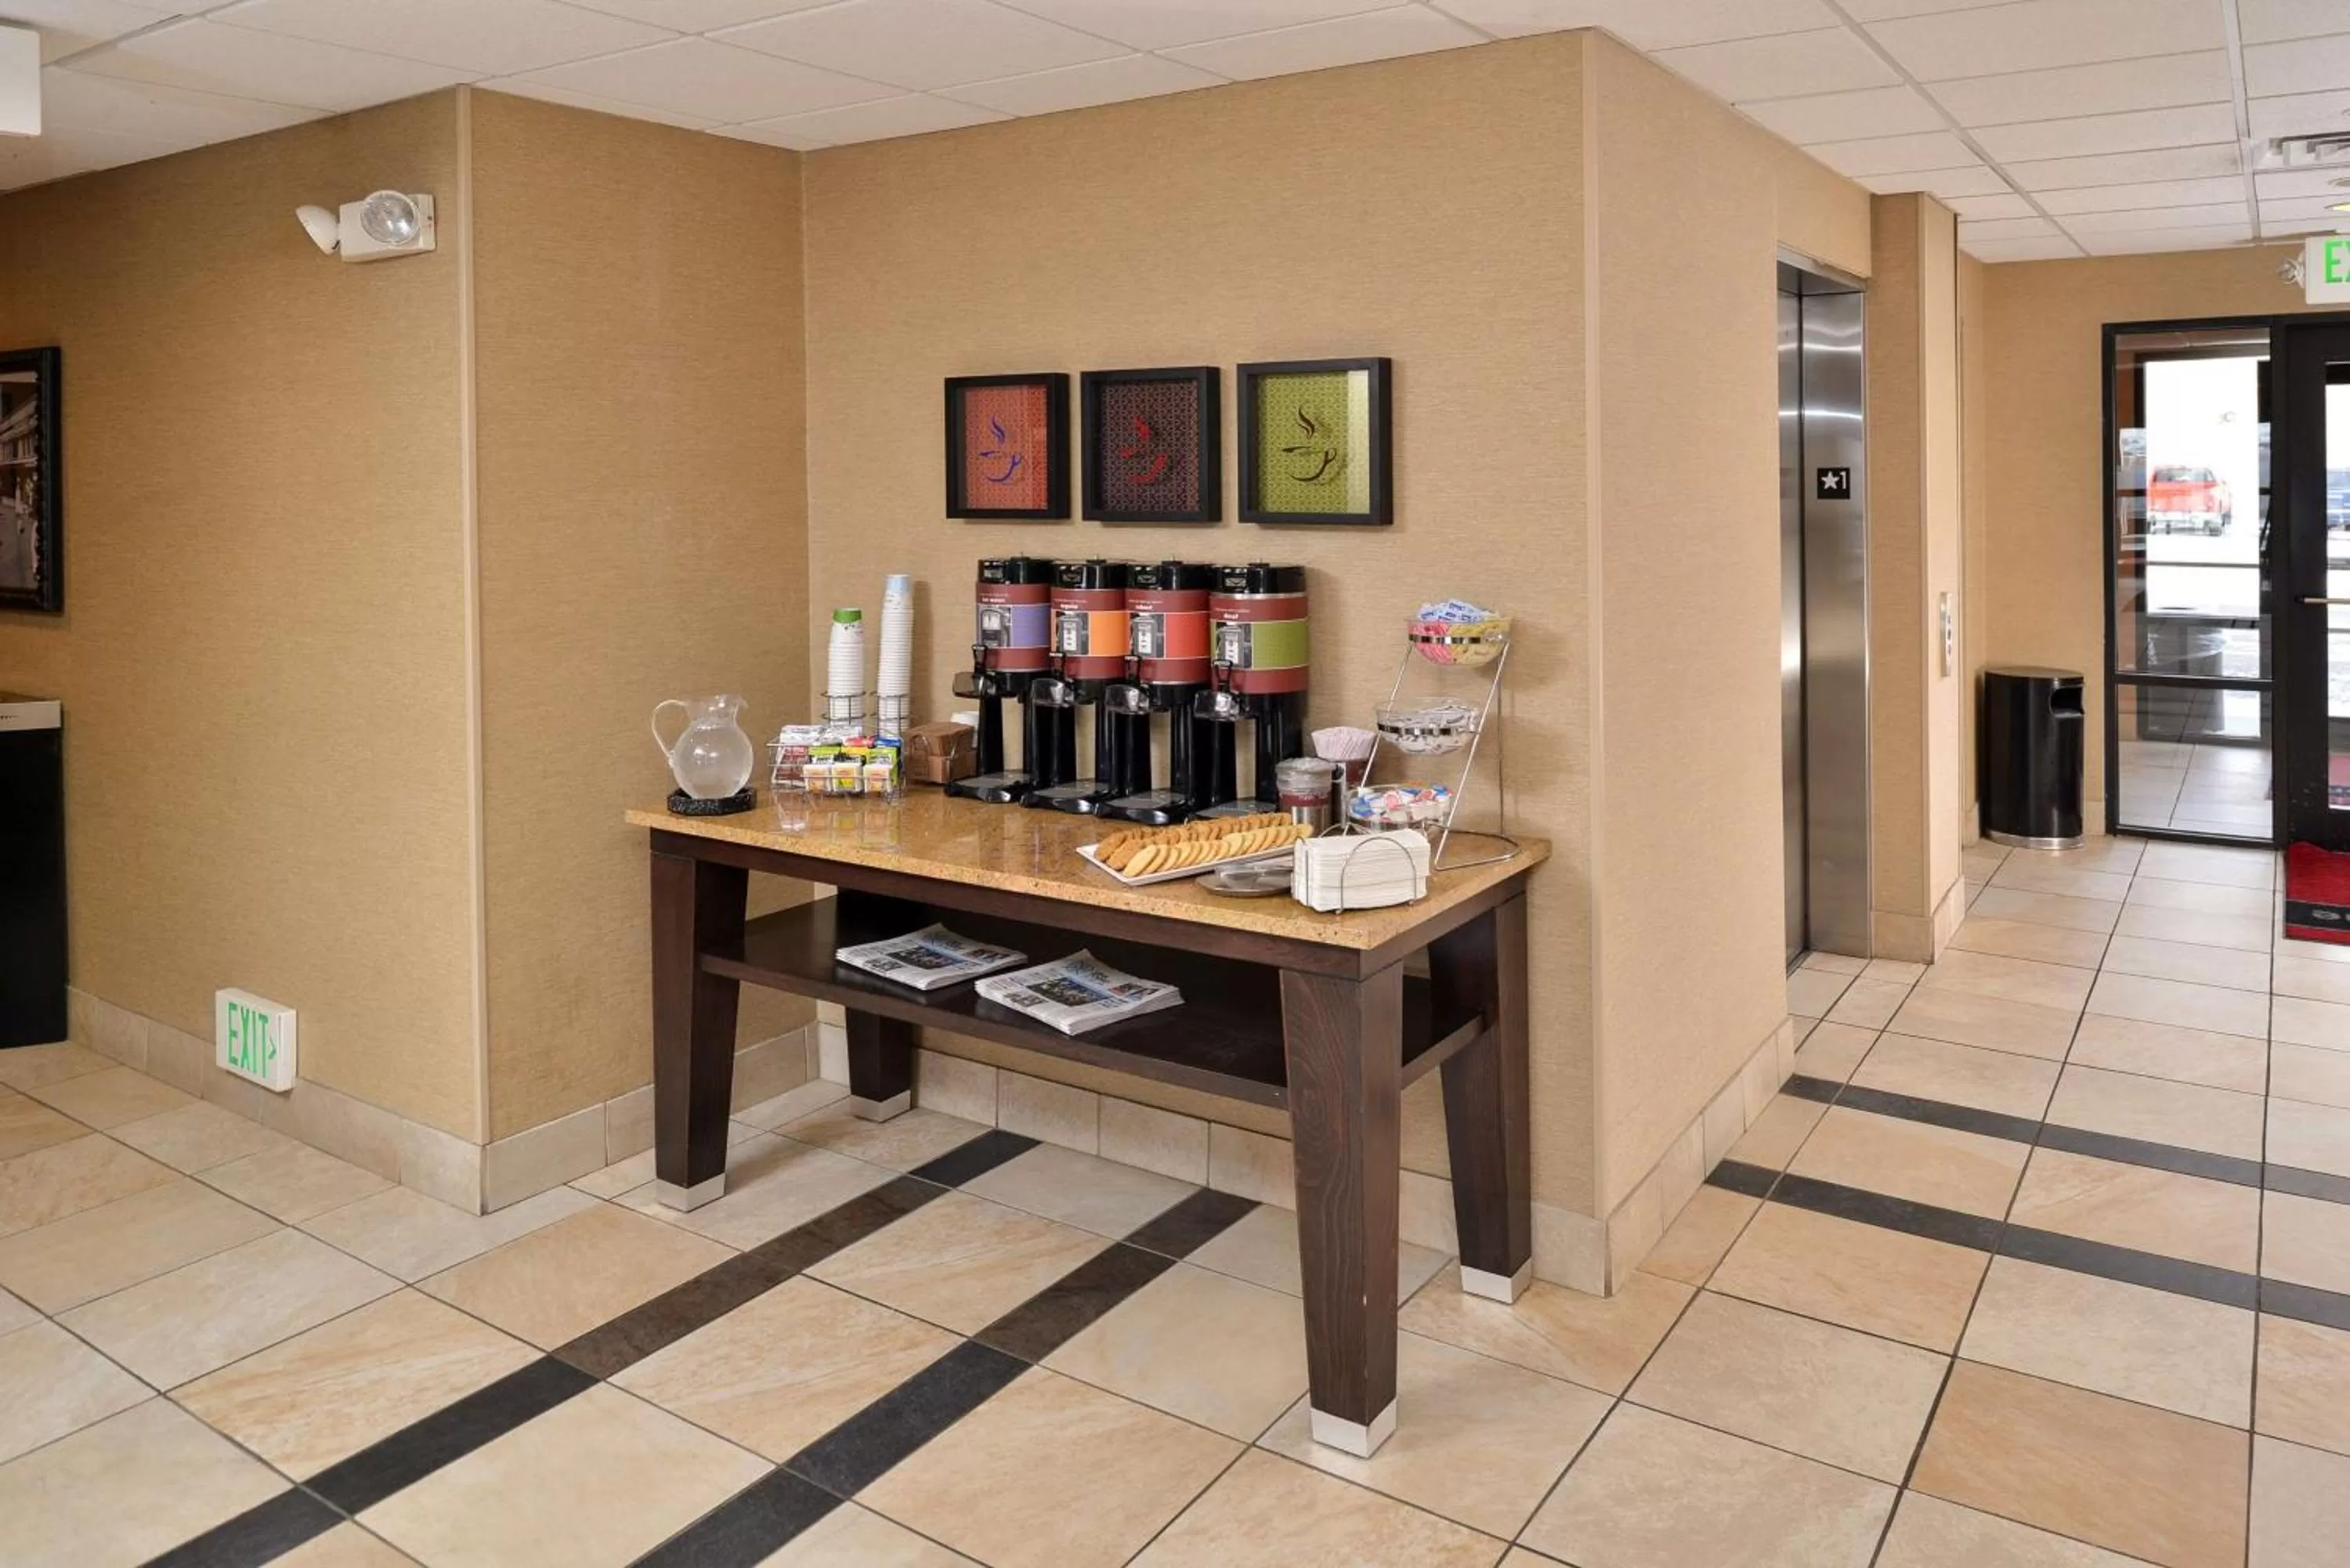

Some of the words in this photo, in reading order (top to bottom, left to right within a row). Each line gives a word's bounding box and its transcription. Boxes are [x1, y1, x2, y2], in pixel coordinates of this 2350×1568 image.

[2324, 240, 2350, 283] E
[1839, 471, 1846, 490] 1
[228, 1002, 269, 1078] EXIT
